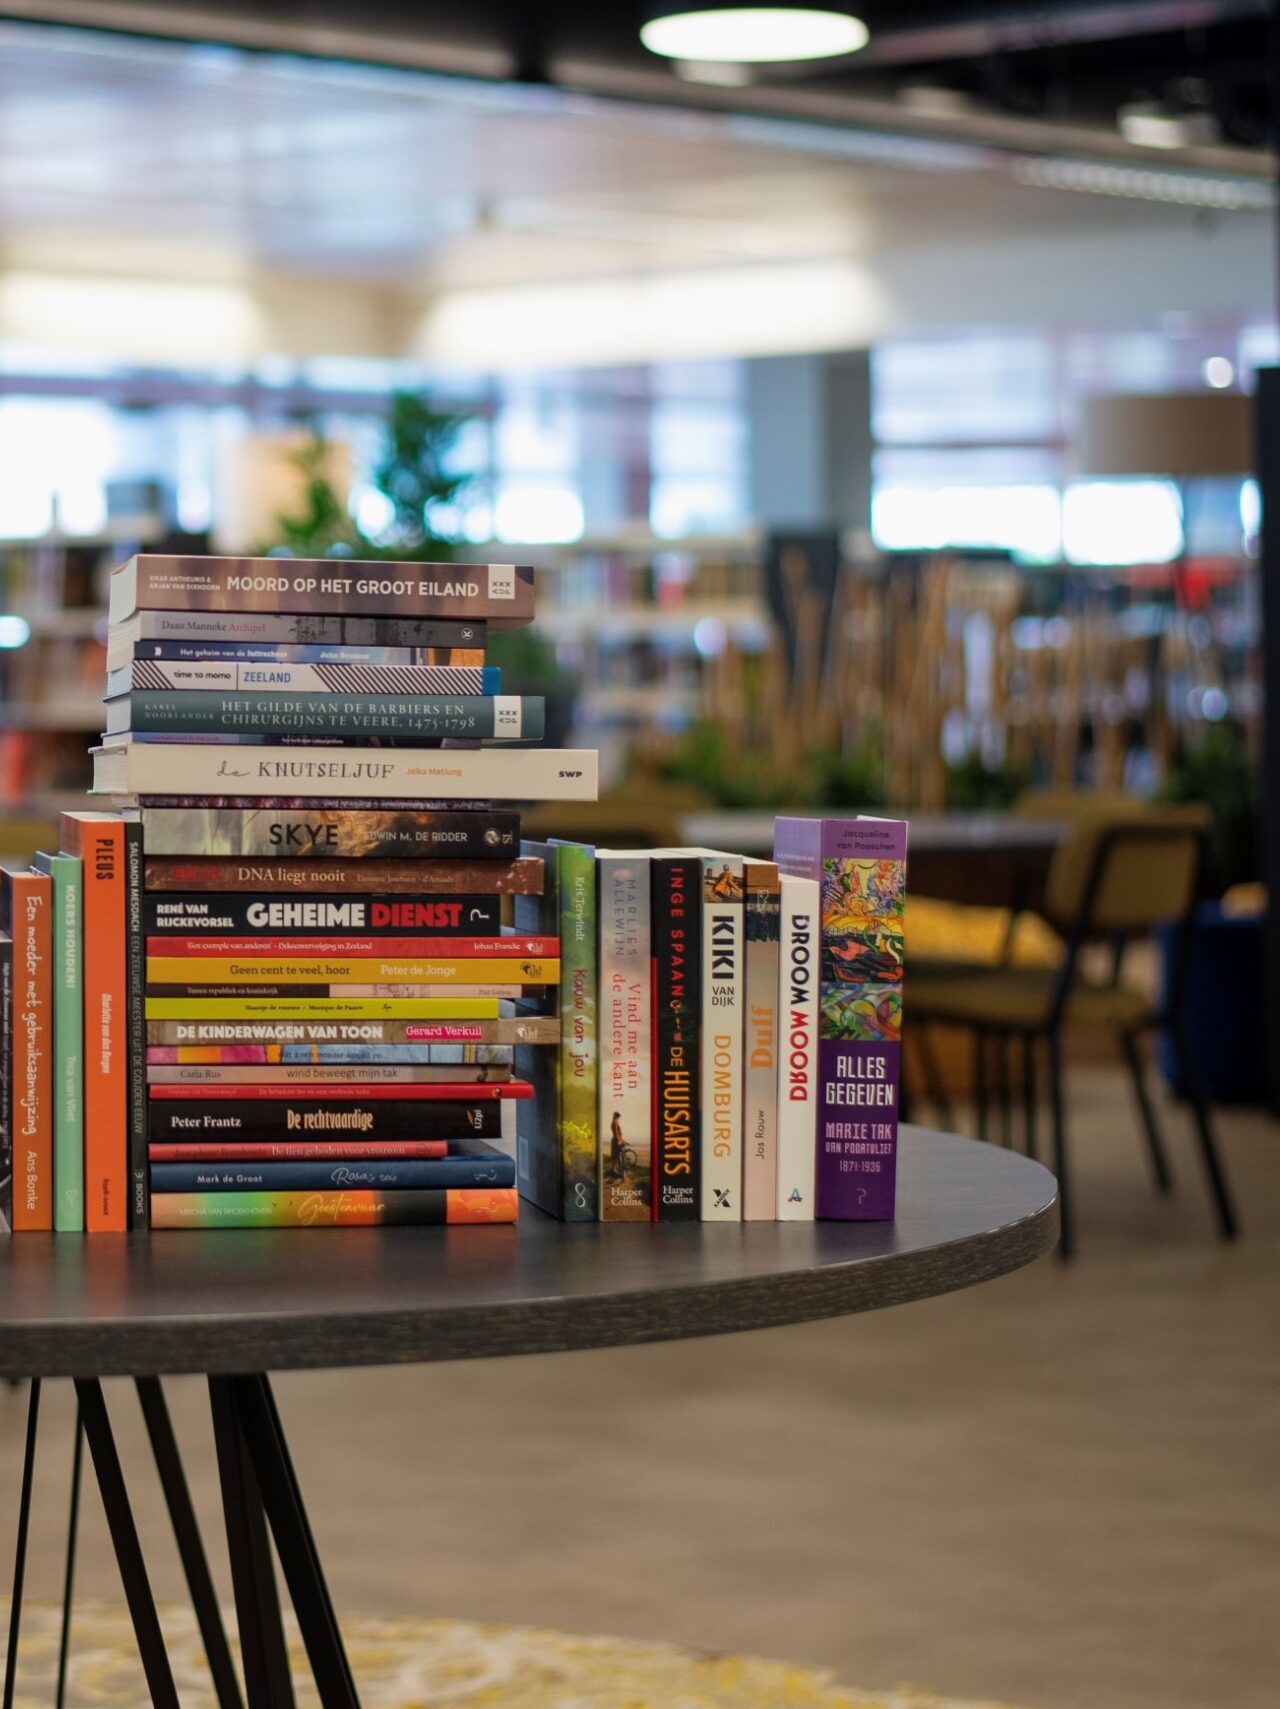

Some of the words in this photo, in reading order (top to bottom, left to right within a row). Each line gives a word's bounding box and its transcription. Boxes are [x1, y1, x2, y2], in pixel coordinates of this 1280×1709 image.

[227, 576, 289, 592] MOORD
[293, 577, 317, 593] OP
[320, 579, 352, 594] HET
[356, 580, 415, 596] GROOT
[419, 582, 479, 597] EILAND
[243, 671, 291, 683] ZEELAND
[222, 701, 250, 712] HET
[257, 701, 303, 712] GILDE
[308, 702, 338, 713] VAN
[344, 703, 363, 714] DE
[368, 703, 440, 714] BARBIERS
[446, 704, 464, 715] EN
[259, 761, 395, 778] KNUTSELJUF
[269, 823, 339, 846] SKYE
[96, 839, 114, 880] PLEUS
[129, 841, 139, 887] SALOMON
[238, 867, 274, 881] DNA
[277, 868, 306, 885] liegt
[310, 868, 345, 882] nooit
[671, 868, 684, 917] INGE
[26, 896, 42, 921] Een
[130, 888, 139, 932] MESDACH
[156, 902, 184, 915] RENÉ
[185, 904, 208, 915] VAN
[246, 902, 366, 928] GEHEIME
[372, 903, 463, 928] DIENST
[26, 926, 43, 975] moeder
[711, 915, 734, 979] KIKI
[230, 965, 258, 975] Geen
[260, 965, 284, 975] cent
[286, 965, 297, 975] te
[299, 965, 324, 977] veel,
[325, 964, 350, 975] hoor
[671, 929, 684, 996] SPAAN
[791, 915, 810, 1005] DROOM
[26, 981, 42, 1008] met
[612, 973, 626, 995] de
[627, 983, 641, 1023] Vind
[176, 1026, 194, 1039] DE
[198, 1026, 304, 1040] KINDERWAGEN
[307, 1026, 338, 1039] VAN
[339, 1026, 383, 1039] TOON
[406, 1026, 442, 1036] Gerard
[445, 1026, 482, 1036] Verkuil
[612, 999, 626, 1056] andere
[628, 1031, 637, 1054] me
[671, 1046, 683, 1067] DE
[837, 1056, 886, 1079] ALLES
[20, 1012, 43, 1135] gebruiksaanwijzing
[612, 1061, 626, 1098] kant
[628, 1060, 638, 1089] aan
[713, 1035, 732, 1158] DOMBURG
[825, 1082, 894, 1106] GEGEVEN
[171, 1115, 201, 1129] Peter
[203, 1115, 242, 1129] Frantz
[287, 1109, 301, 1129] De
[304, 1108, 373, 1132] rechtvaardige
[664, 1071, 690, 1176] HUISARTS
[825, 1122, 868, 1140] MARIE
[871, 1123, 892, 1140] TAK
[26, 1150, 38, 1171] Ans
[26, 1174, 38, 1210] Bonke
[663, 1185, 693, 1195] Harper
[663, 1195, 693, 1204] Collins
